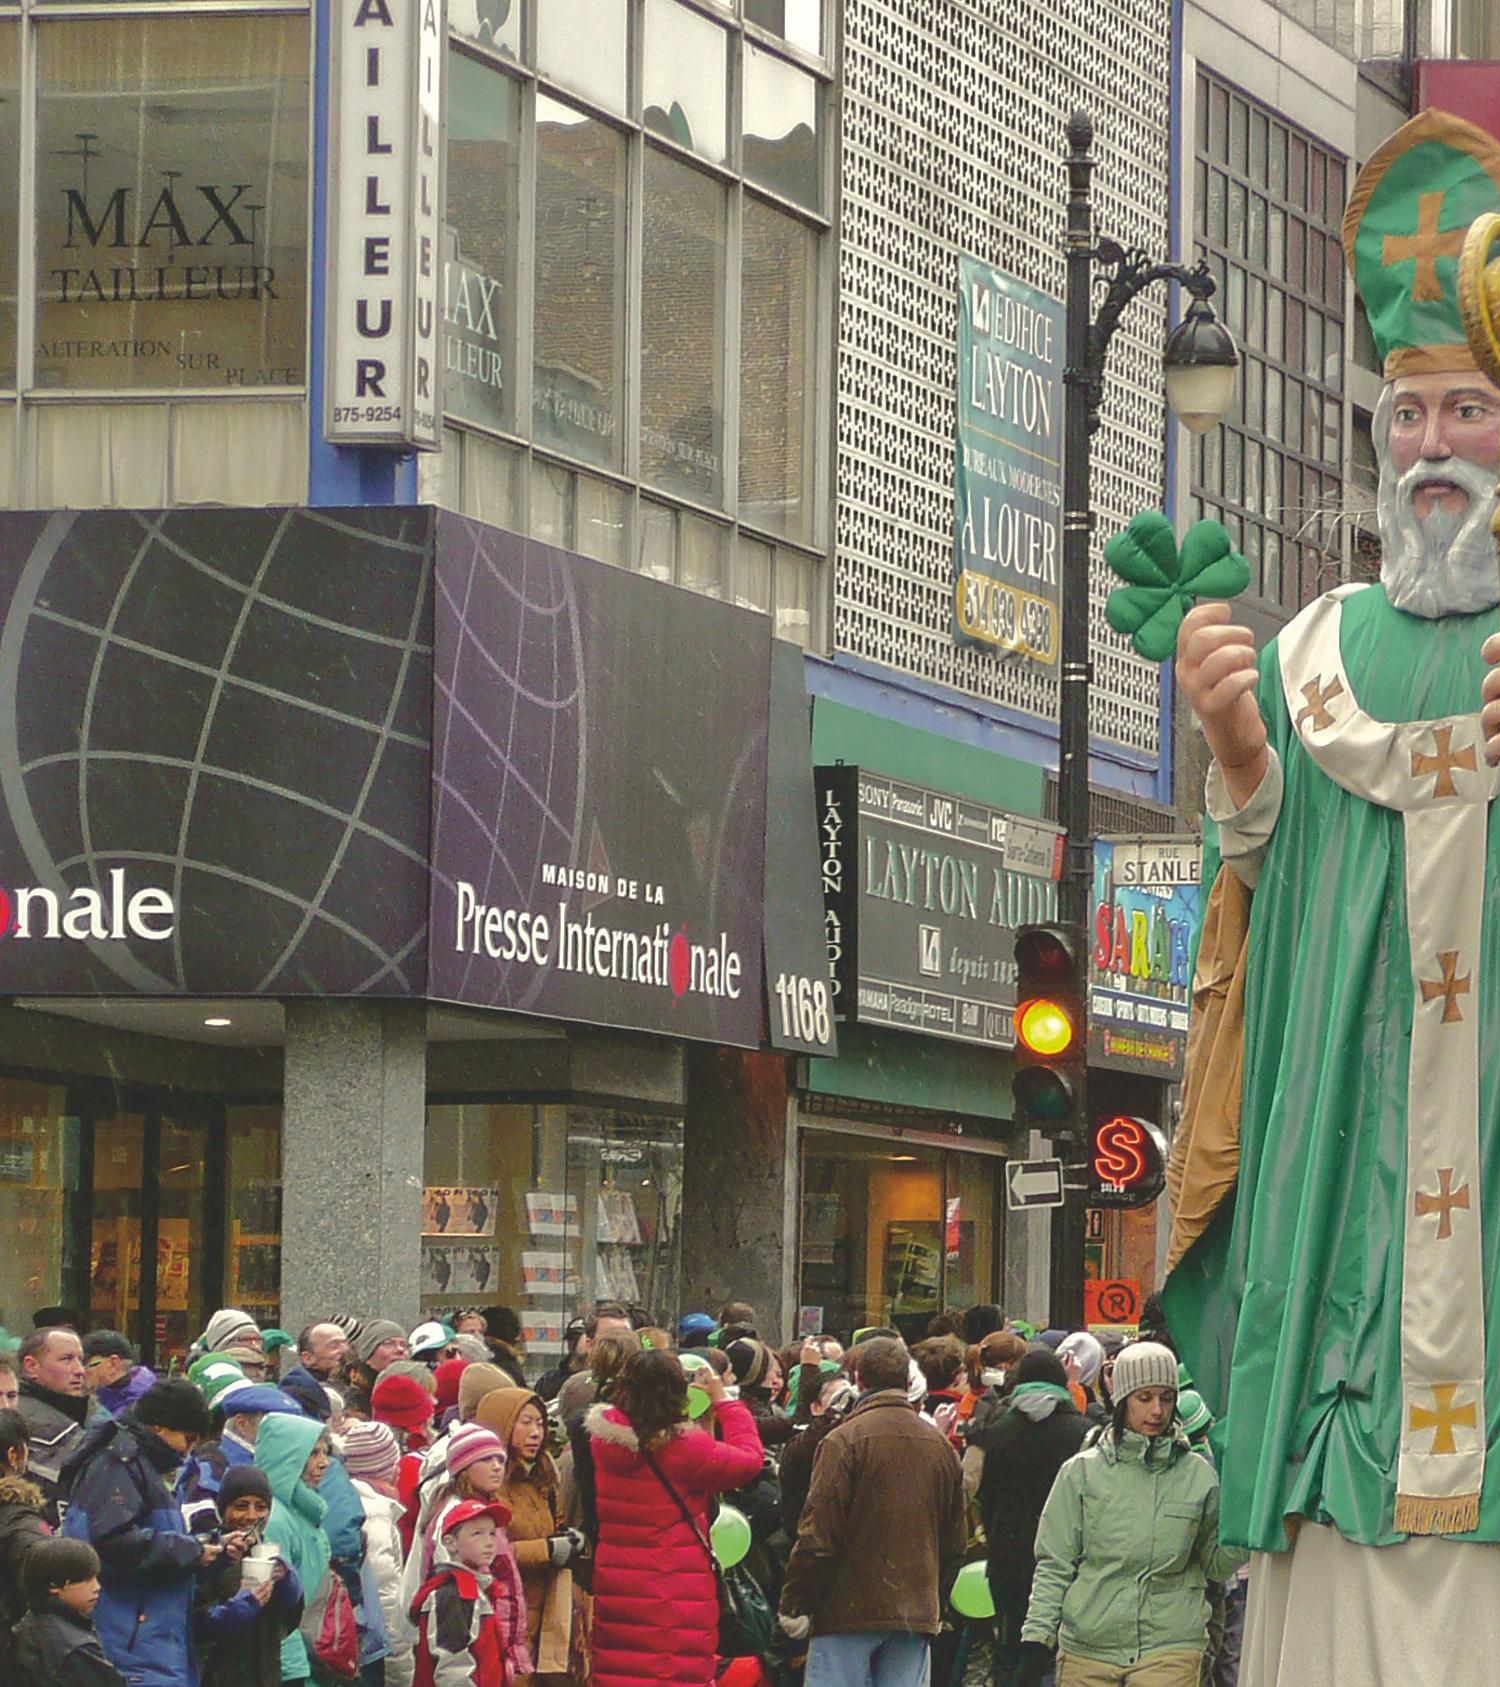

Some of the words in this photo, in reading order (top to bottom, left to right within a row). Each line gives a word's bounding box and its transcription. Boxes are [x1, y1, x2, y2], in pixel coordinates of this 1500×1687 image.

[61, 184, 255, 249] MAX
[52, 266, 280, 303] TAILLEUR
[38, 340, 171, 358] ALTERATION
[176, 353, 220, 370] SUR
[226, 367, 297, 385] PLACE
[333, 406, 402, 423] 875-9254
[972, 345, 1052, 439] LAYTON
[963, 444, 1007, 485] BUREAUX
[983, 497, 1057, 586] LOUER
[858, 783, 889, 808] SONY
[930, 799, 952, 830] JVC
[822, 789, 843, 894] LAYTON
[1158, 848, 1179, 859] RUE
[542, 864, 609, 894] MAISON
[616, 878, 638, 899] DE
[645, 883, 664, 905] LA
[866, 836, 977, 920] LAYTON
[456, 881, 550, 966] Presse
[557, 902, 742, 1000] Internationale
[1094, 902, 1190, 988] SARAH
[775, 973, 830, 1045] 1168
